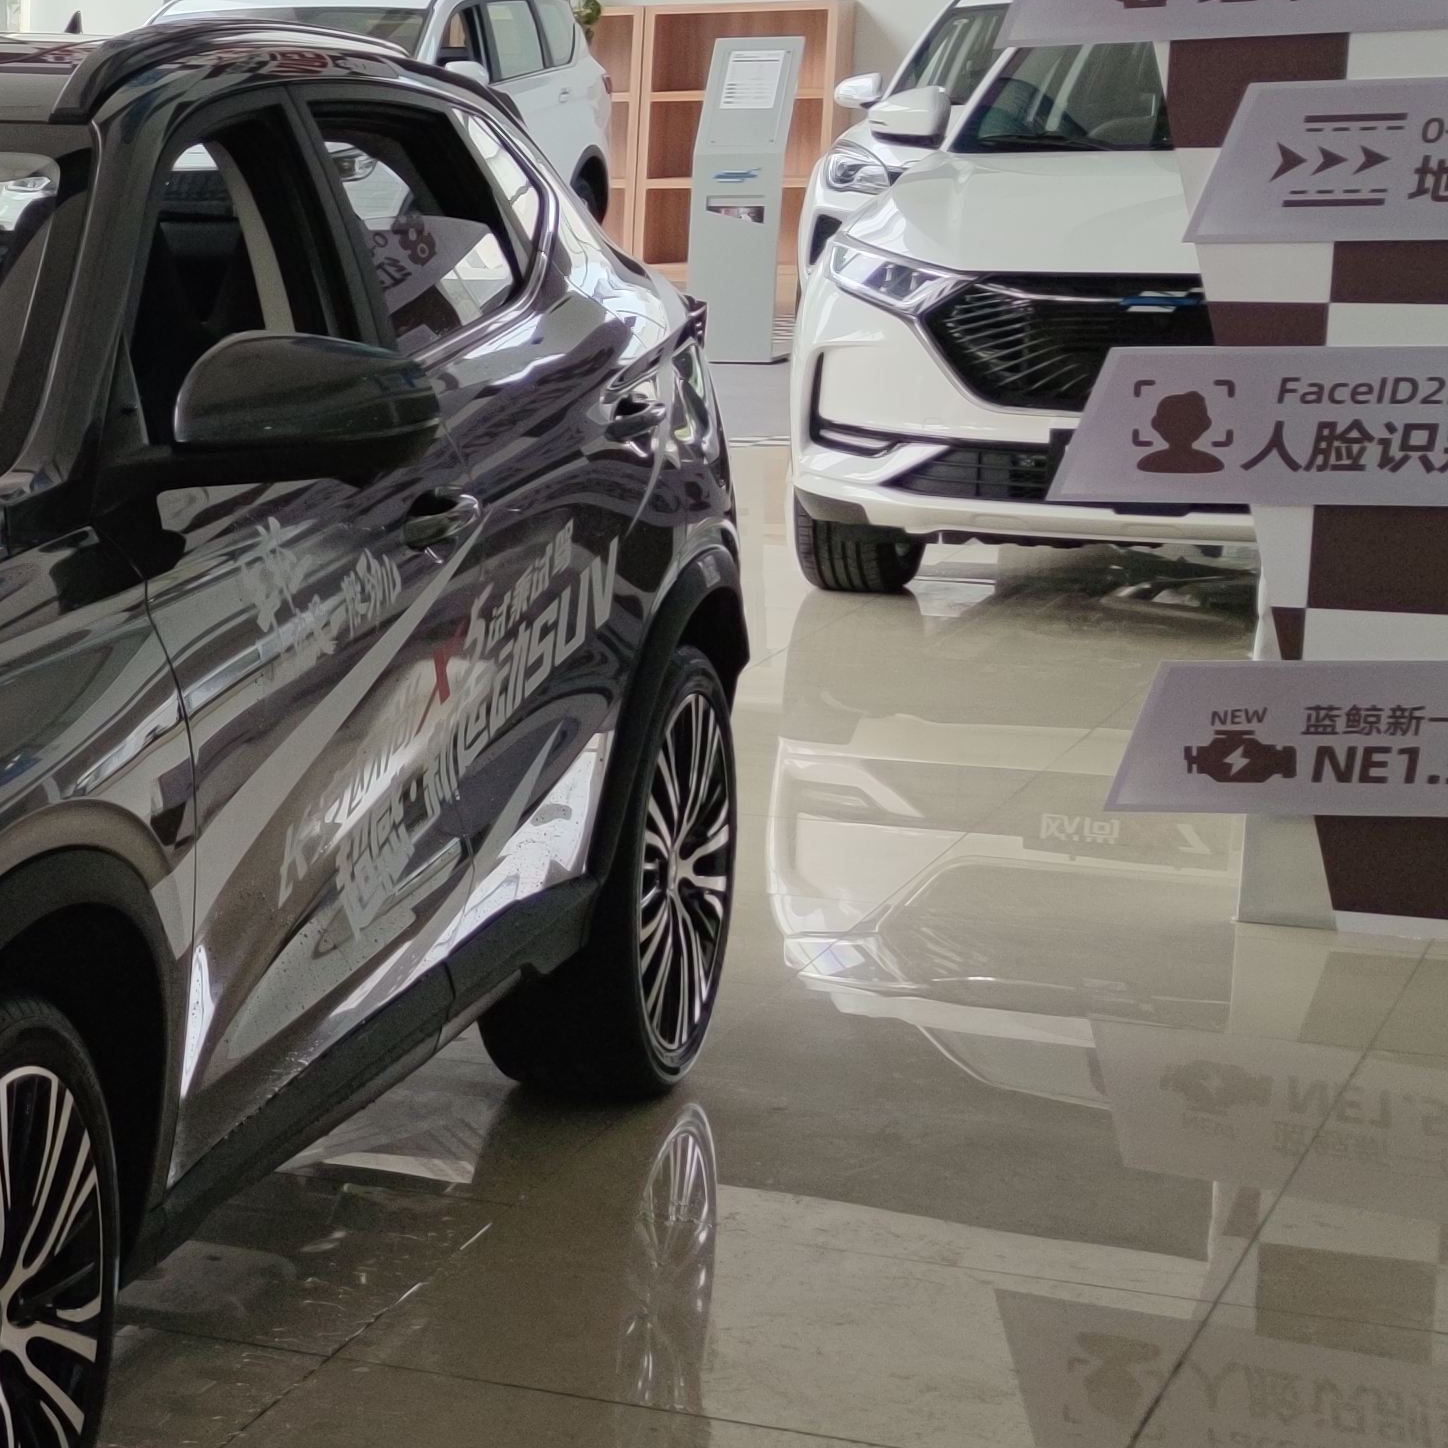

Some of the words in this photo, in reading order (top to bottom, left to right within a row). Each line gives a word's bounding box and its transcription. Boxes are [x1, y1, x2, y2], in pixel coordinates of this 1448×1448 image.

[1240, 419, 1448, 474] 人脸识
[1210, 706, 1268, 726] NEW
[1311, 745, 1448, 785] NE1.
